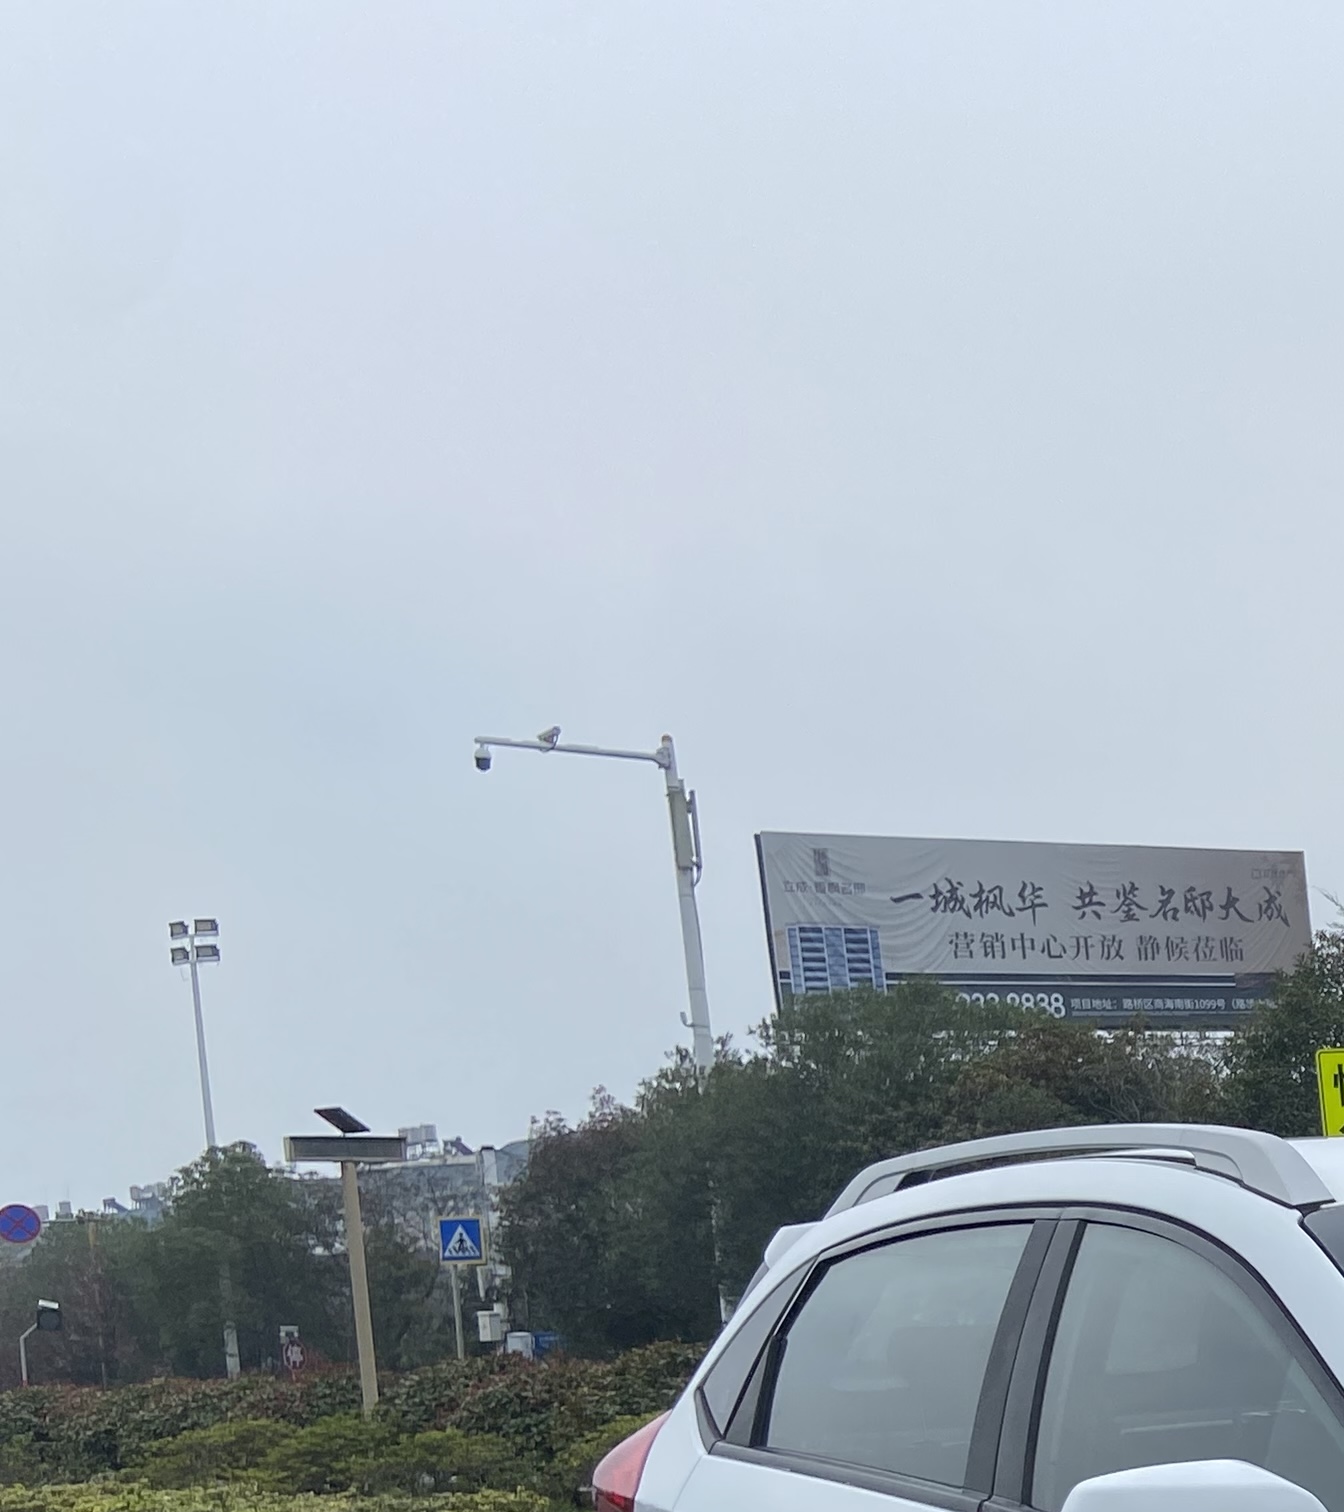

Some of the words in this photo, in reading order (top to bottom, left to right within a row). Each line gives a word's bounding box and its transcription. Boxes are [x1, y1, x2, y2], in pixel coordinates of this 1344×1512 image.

[890, 876, 1049, 926] 一城枫华
[1072, 881, 1290, 927] 共鉴名邸大成
[949, 931, 1125, 961] 营销中心开放
[1136, 934, 1244, 962] 静候莅临
